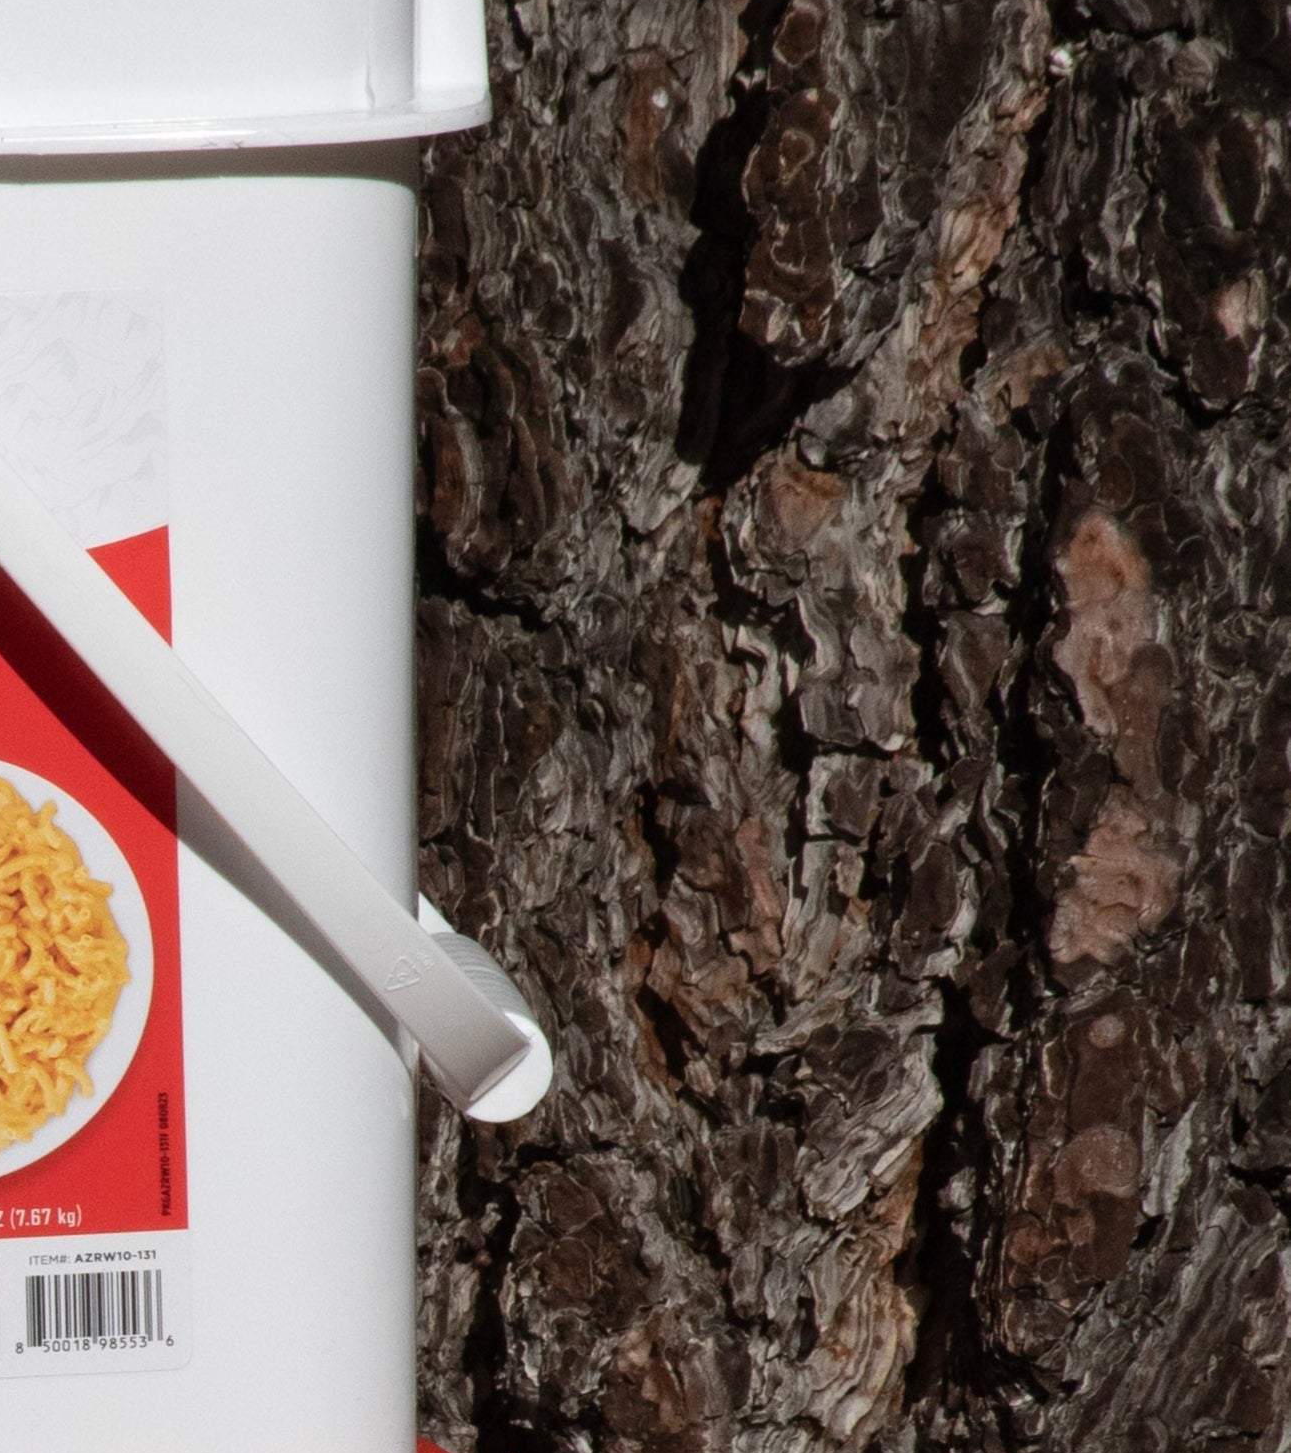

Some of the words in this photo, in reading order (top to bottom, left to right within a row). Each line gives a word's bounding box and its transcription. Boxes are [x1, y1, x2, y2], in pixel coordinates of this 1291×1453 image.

[10, 1208, 51, 1229] (7.67
[58, 1205, 81, 1227] kg)
[75, 1250, 156, 1263] AZRW10-131
[43, 1339, 91, 1352] 50018
[100, 1336, 148, 1350] 98553
